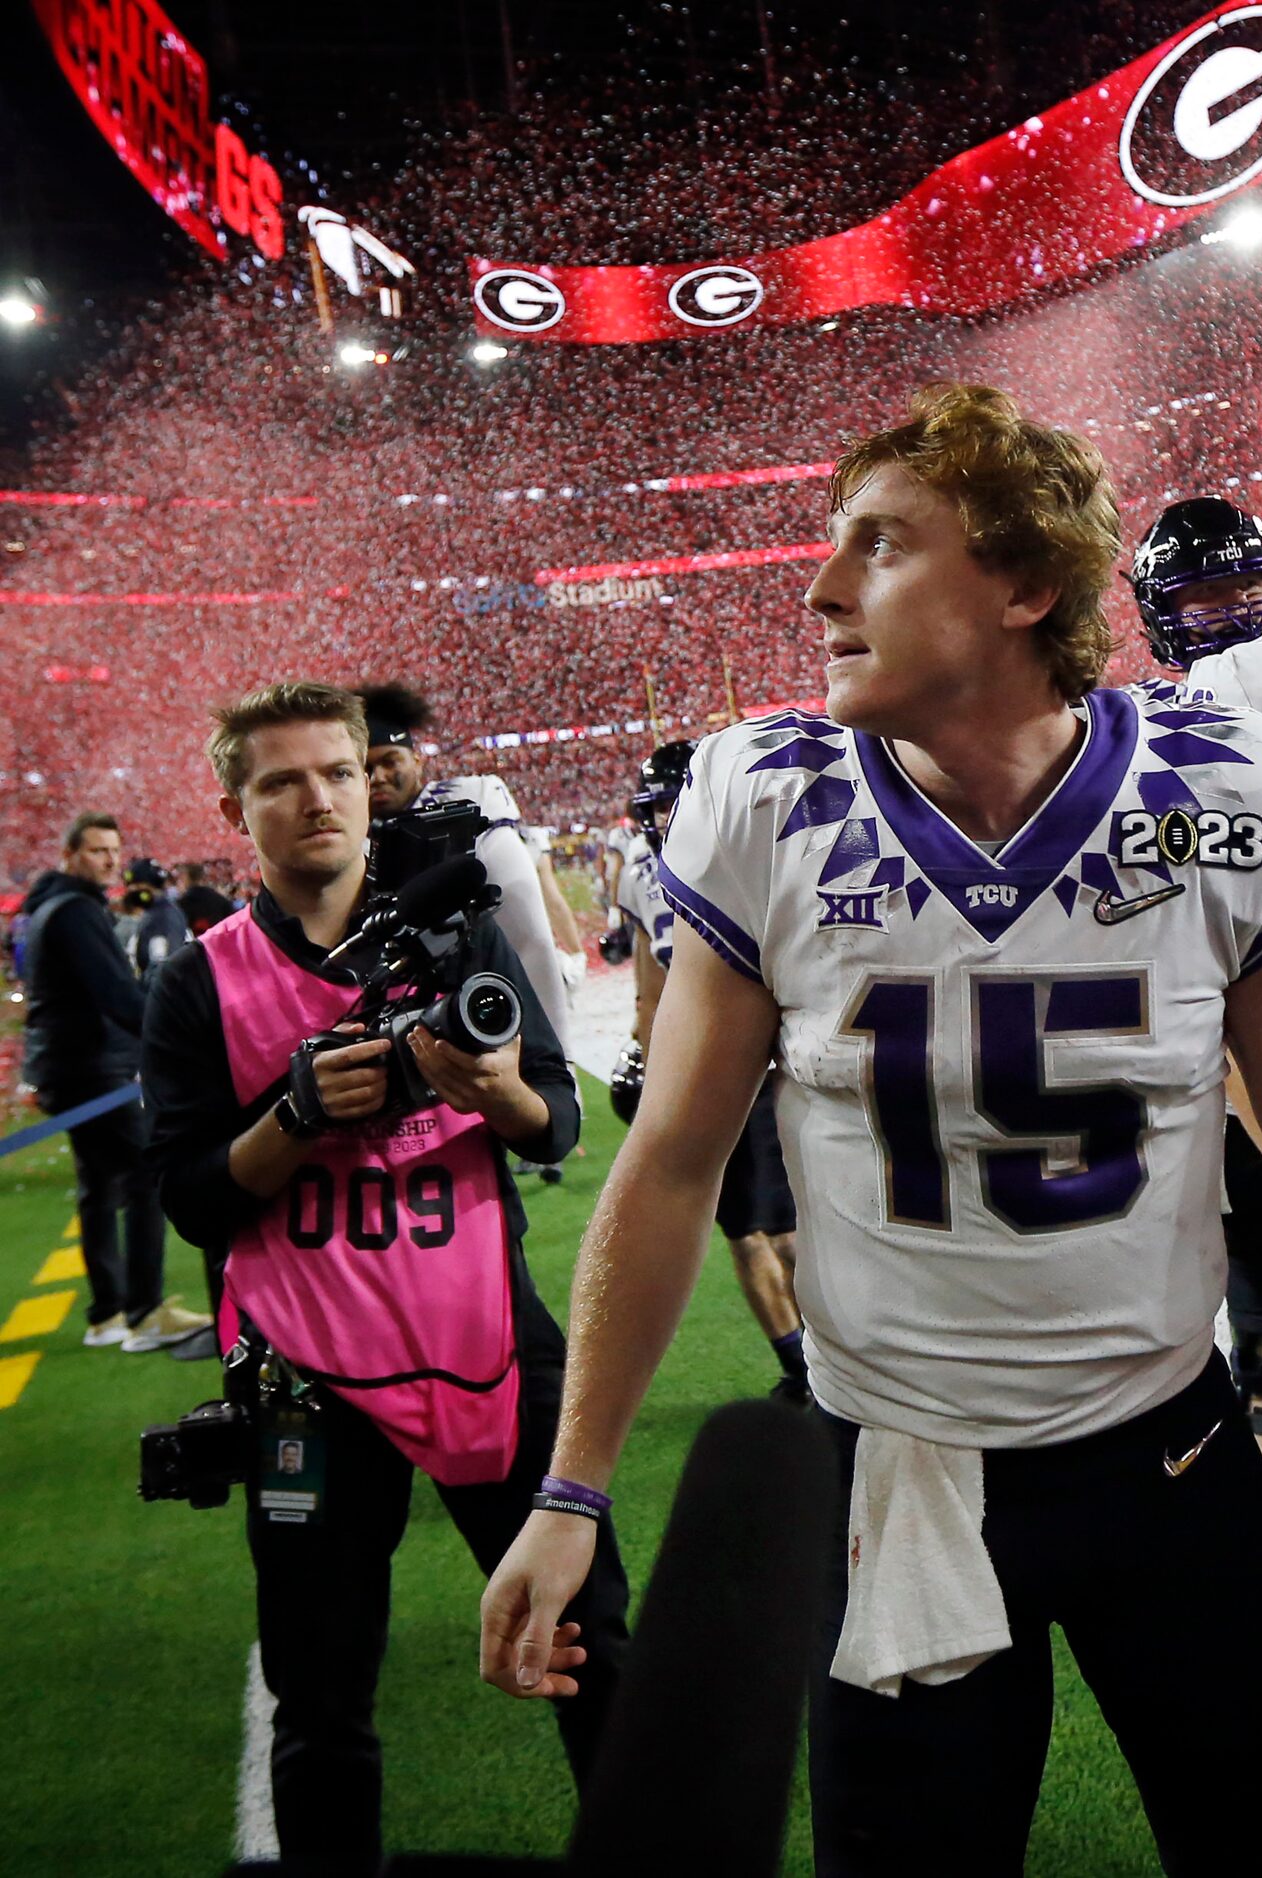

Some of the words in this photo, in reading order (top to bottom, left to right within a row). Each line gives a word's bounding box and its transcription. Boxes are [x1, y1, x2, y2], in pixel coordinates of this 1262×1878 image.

[1217, 545, 1243, 563] TCU
[817, 889, 884, 927] XII
[965, 884, 1018, 908] TCU
[836, 975, 1150, 1234] 15
[393, 1139, 426, 1153] 2023
[286, 1163, 455, 1250] 009
